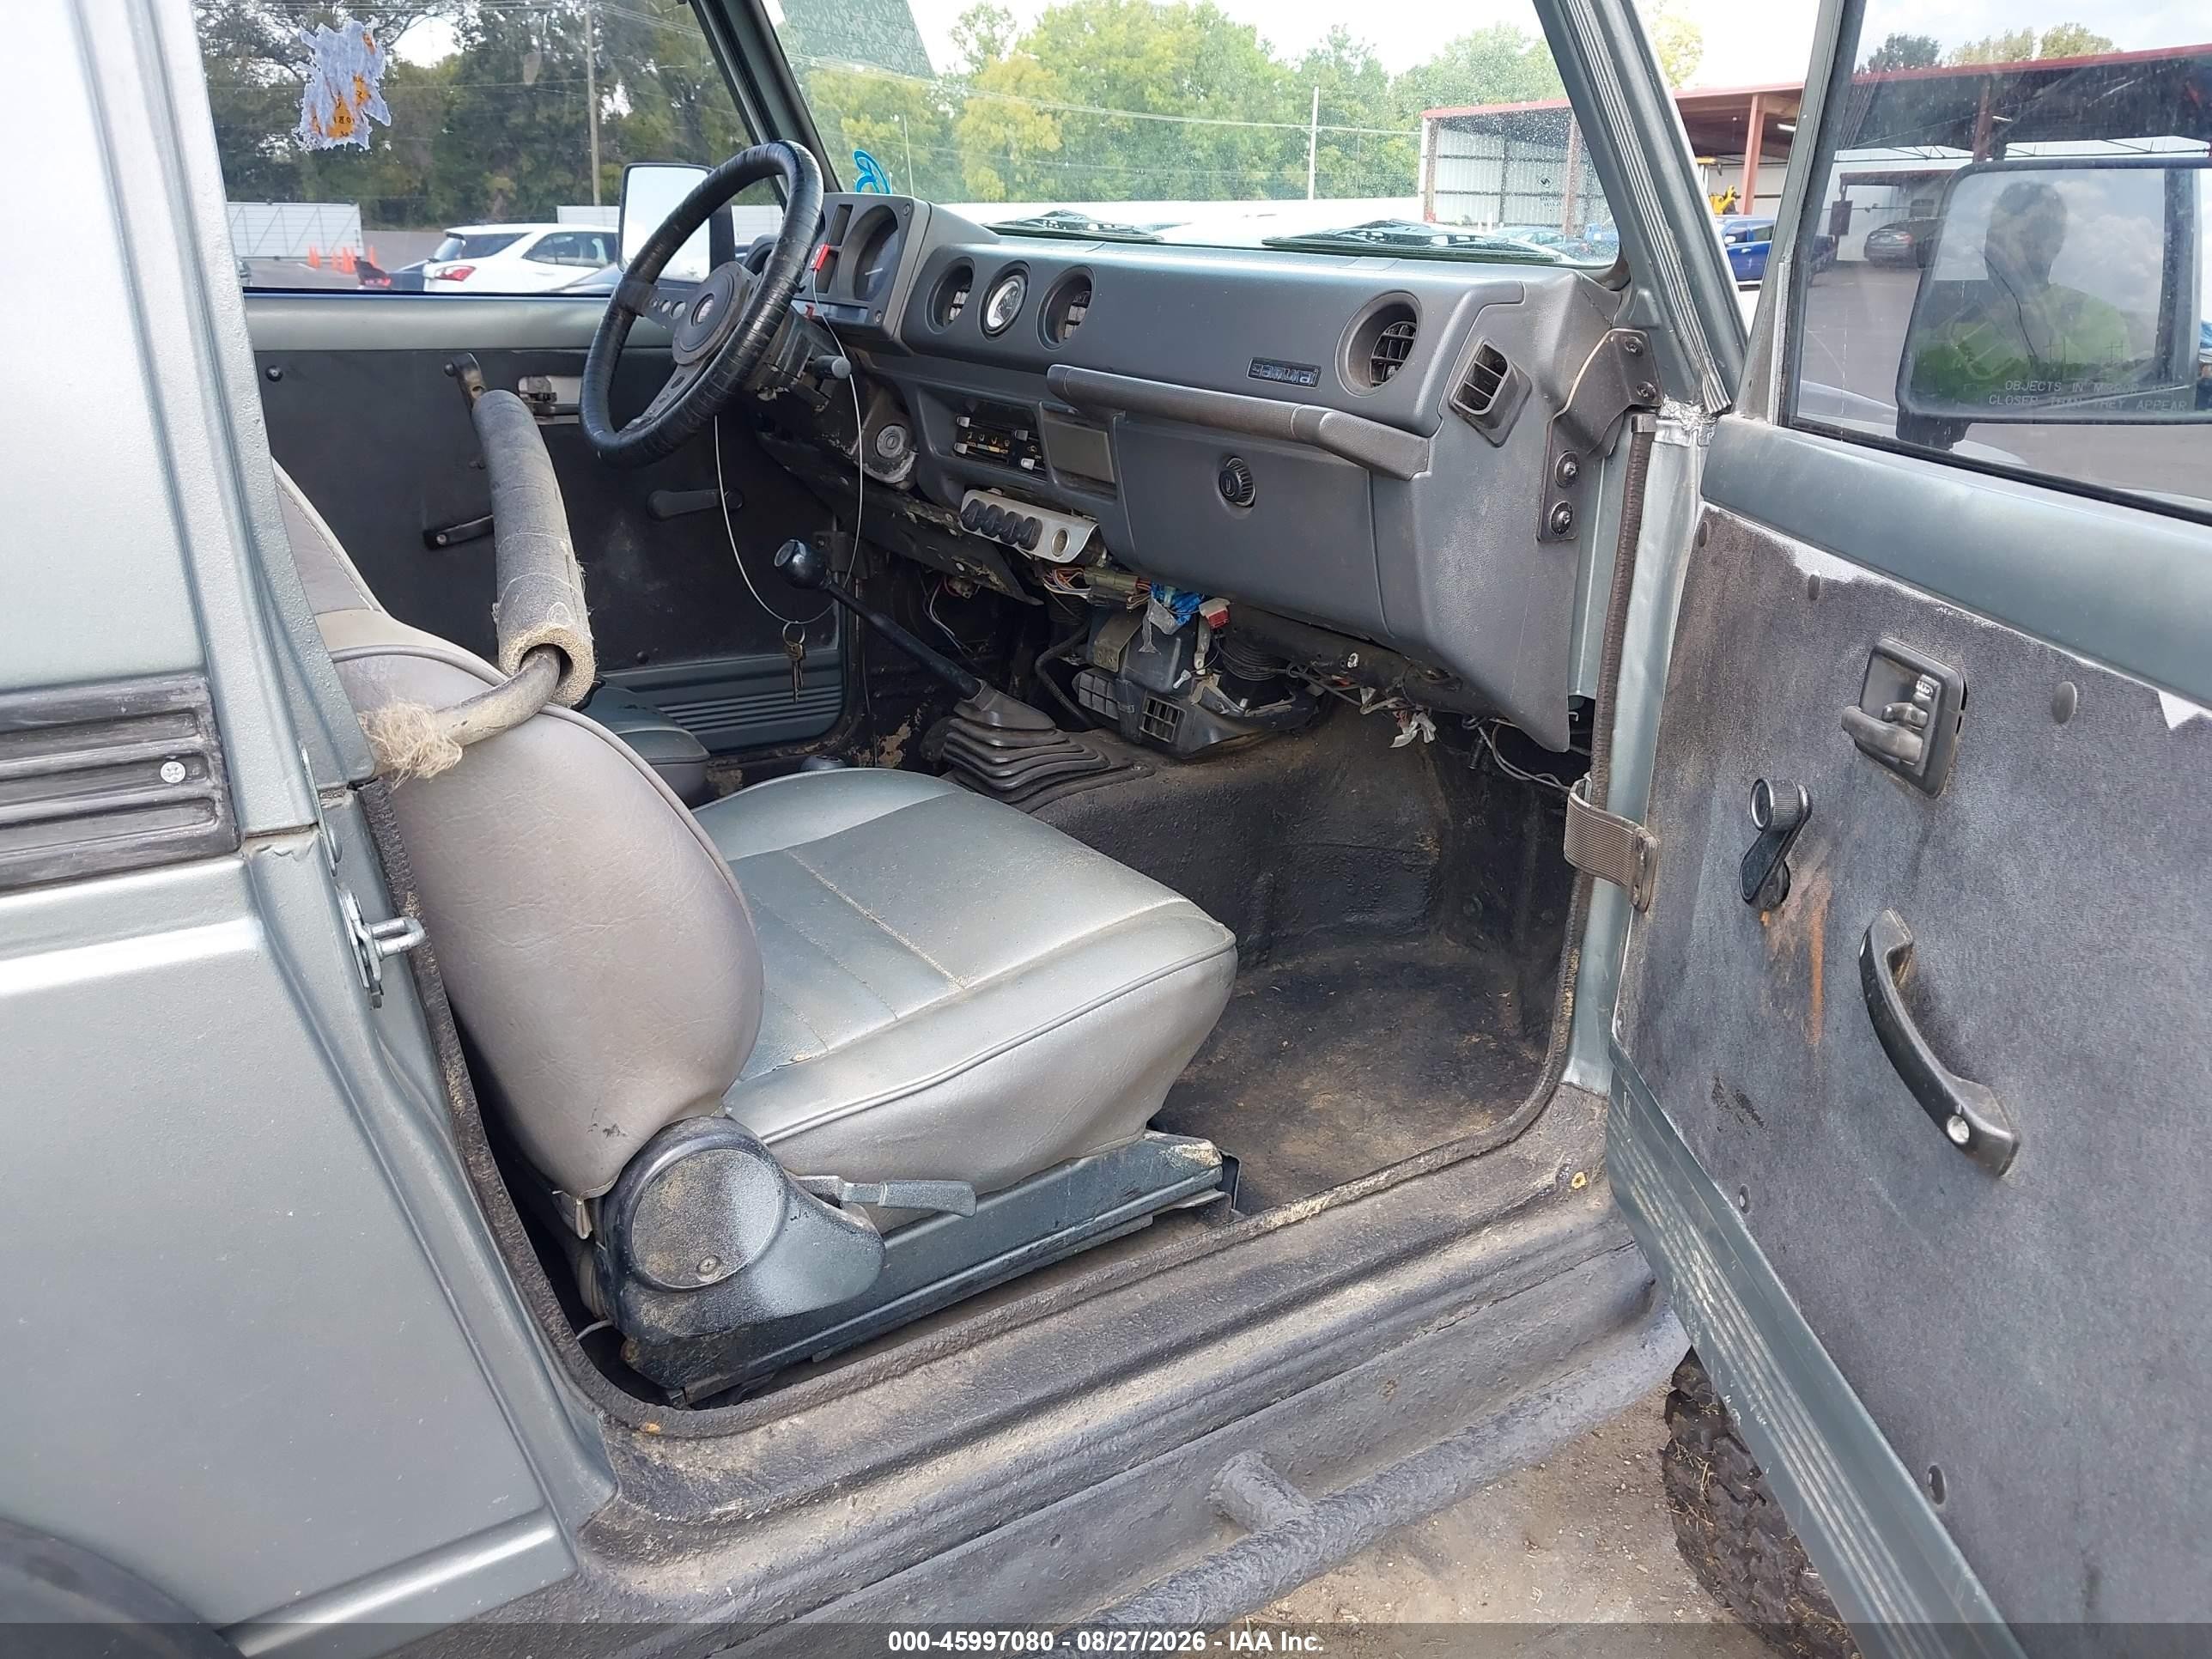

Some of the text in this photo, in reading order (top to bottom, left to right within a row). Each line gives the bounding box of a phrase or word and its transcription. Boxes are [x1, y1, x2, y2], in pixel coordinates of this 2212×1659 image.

[2005, 380, 2062, 392] OBJECTS
[2072, 383, 2083, 392] IN
[2136, 400, 2188, 411] APPEAR
